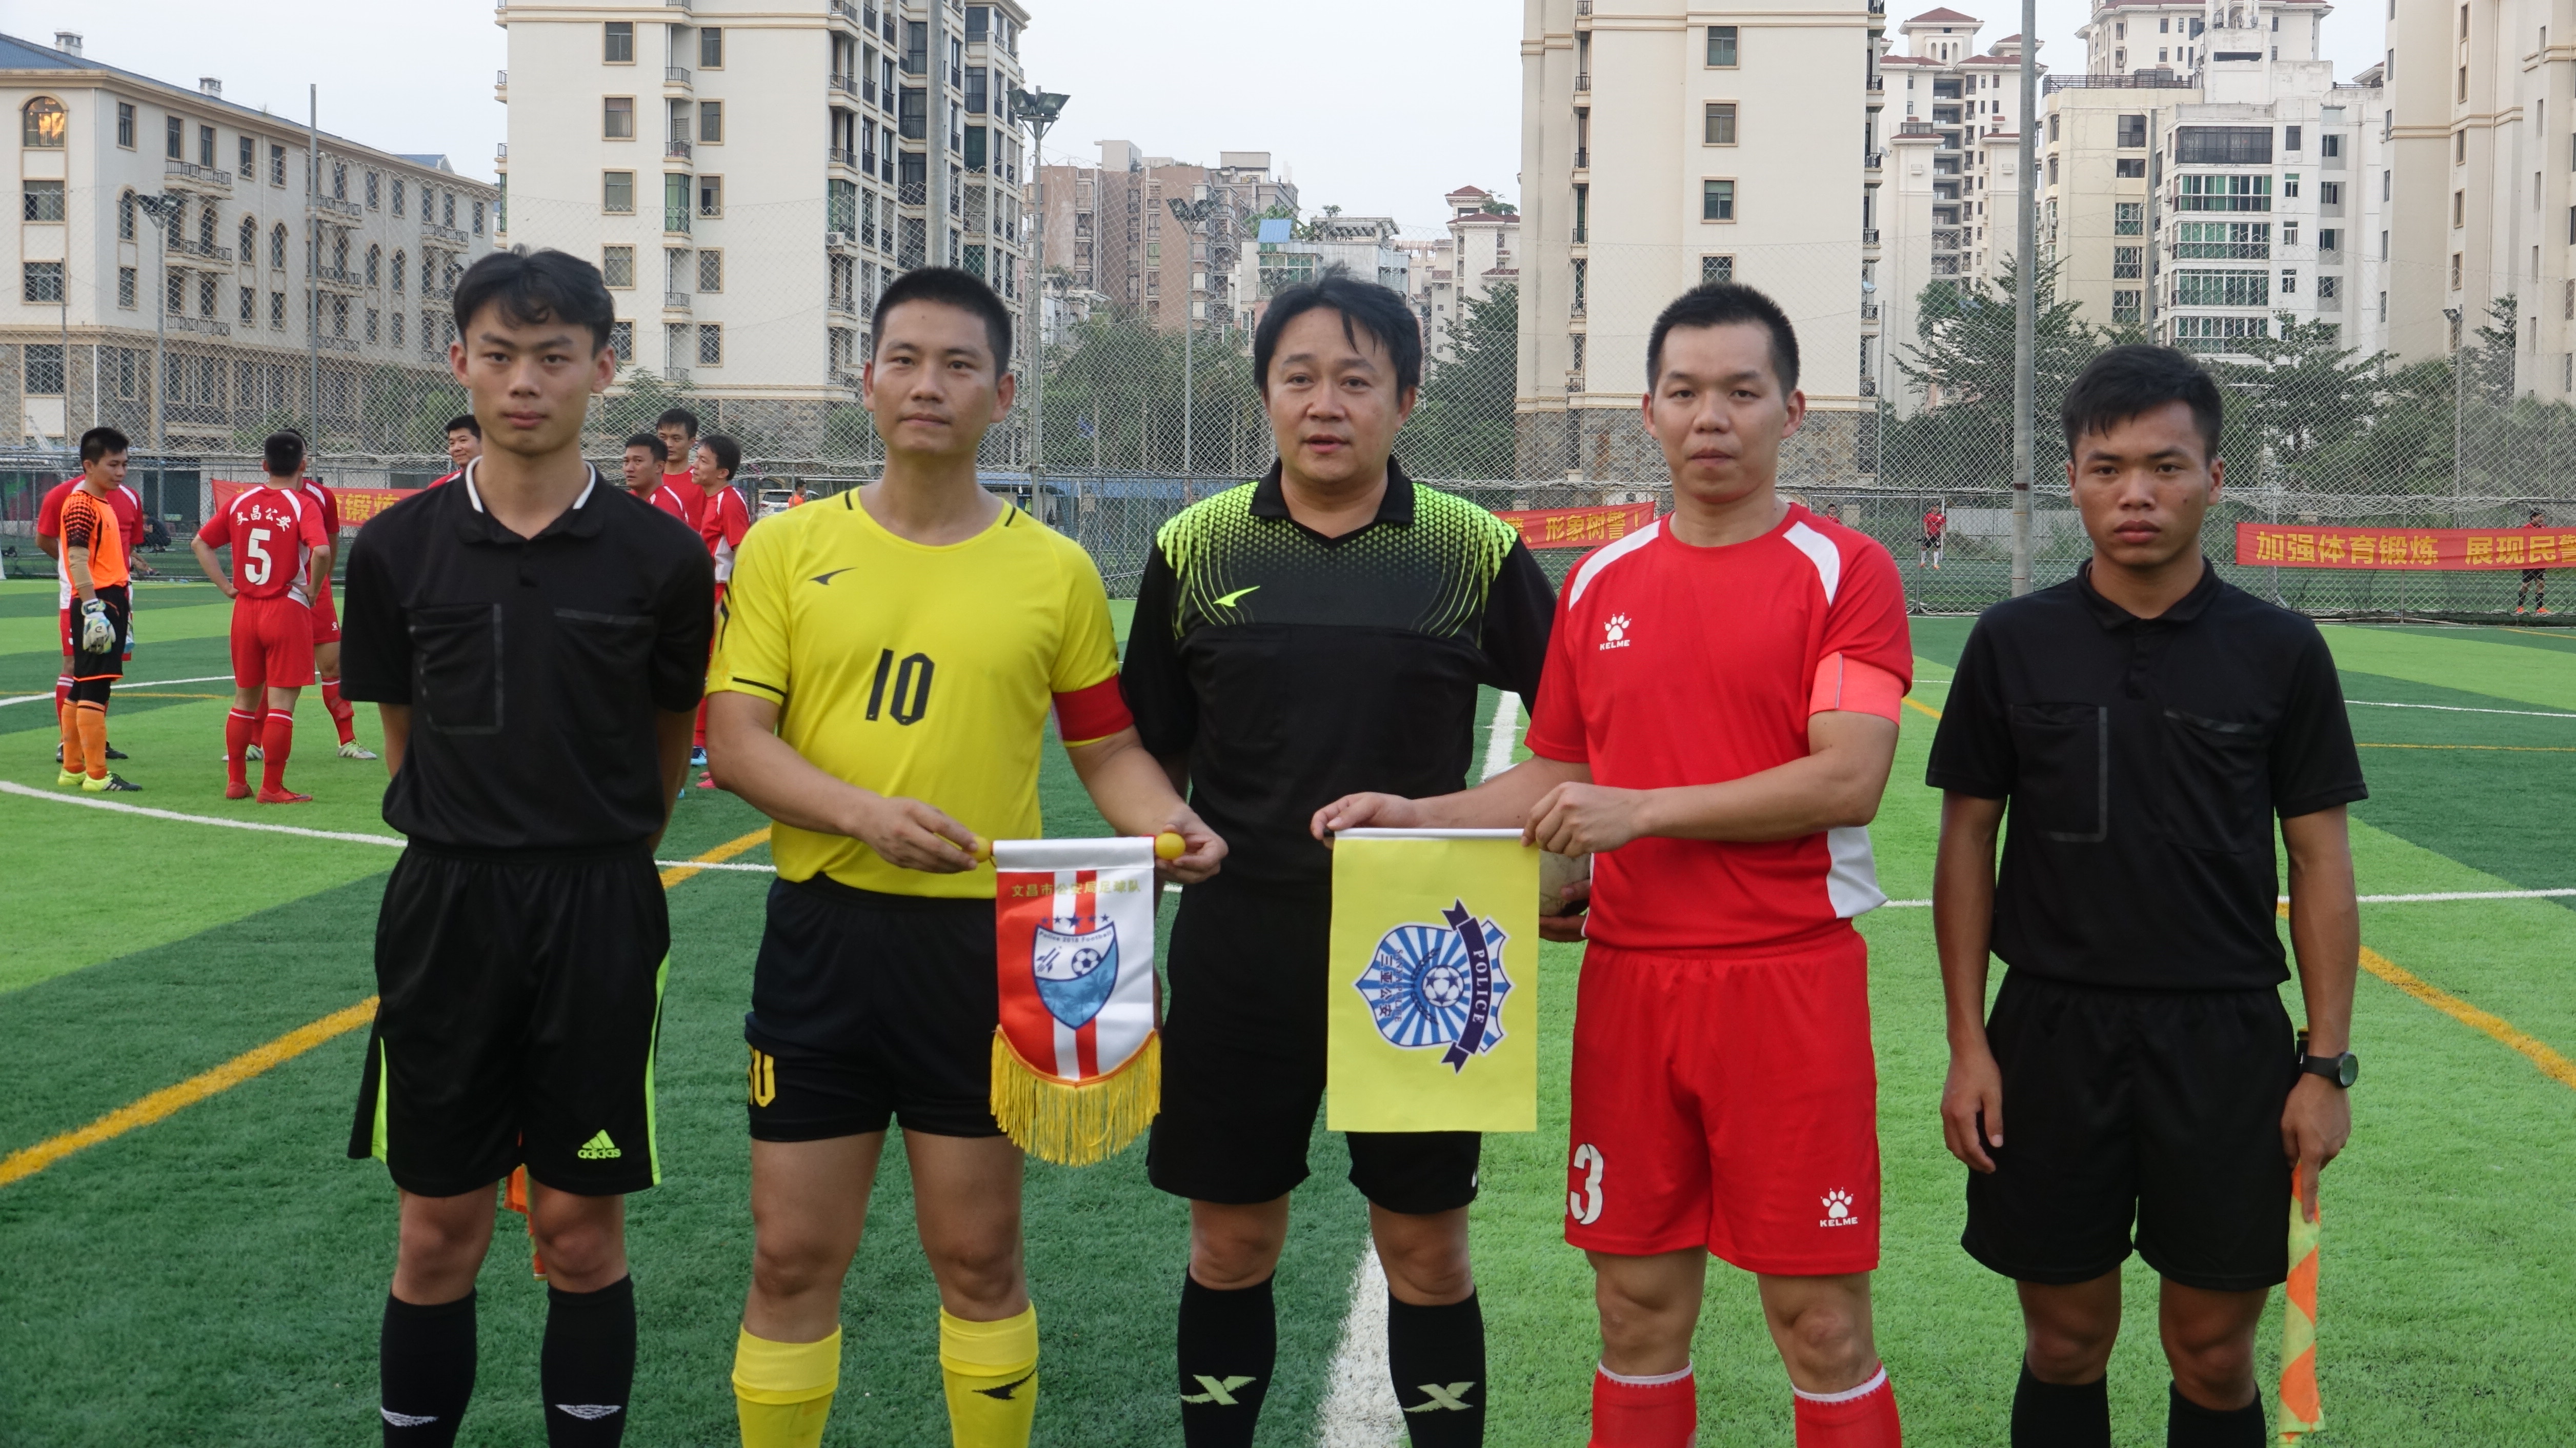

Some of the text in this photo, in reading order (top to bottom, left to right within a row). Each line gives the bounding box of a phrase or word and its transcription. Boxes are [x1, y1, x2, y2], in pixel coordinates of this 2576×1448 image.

[245, 528, 272, 586] 5
[2256, 530, 2439, 565] 加强体育锻炼
[1599, 639, 1631, 651] KELME
[864, 648, 935, 726] 10
[1011, 878, 1141, 897] 文昌市公安局足球队
[1379, 954, 1393, 1017] 三亚公安
[1472, 949, 1488, 1024] POLICE
[577, 1148, 621, 1159] adidas
[1819, 1217, 1858, 1228] KELME
